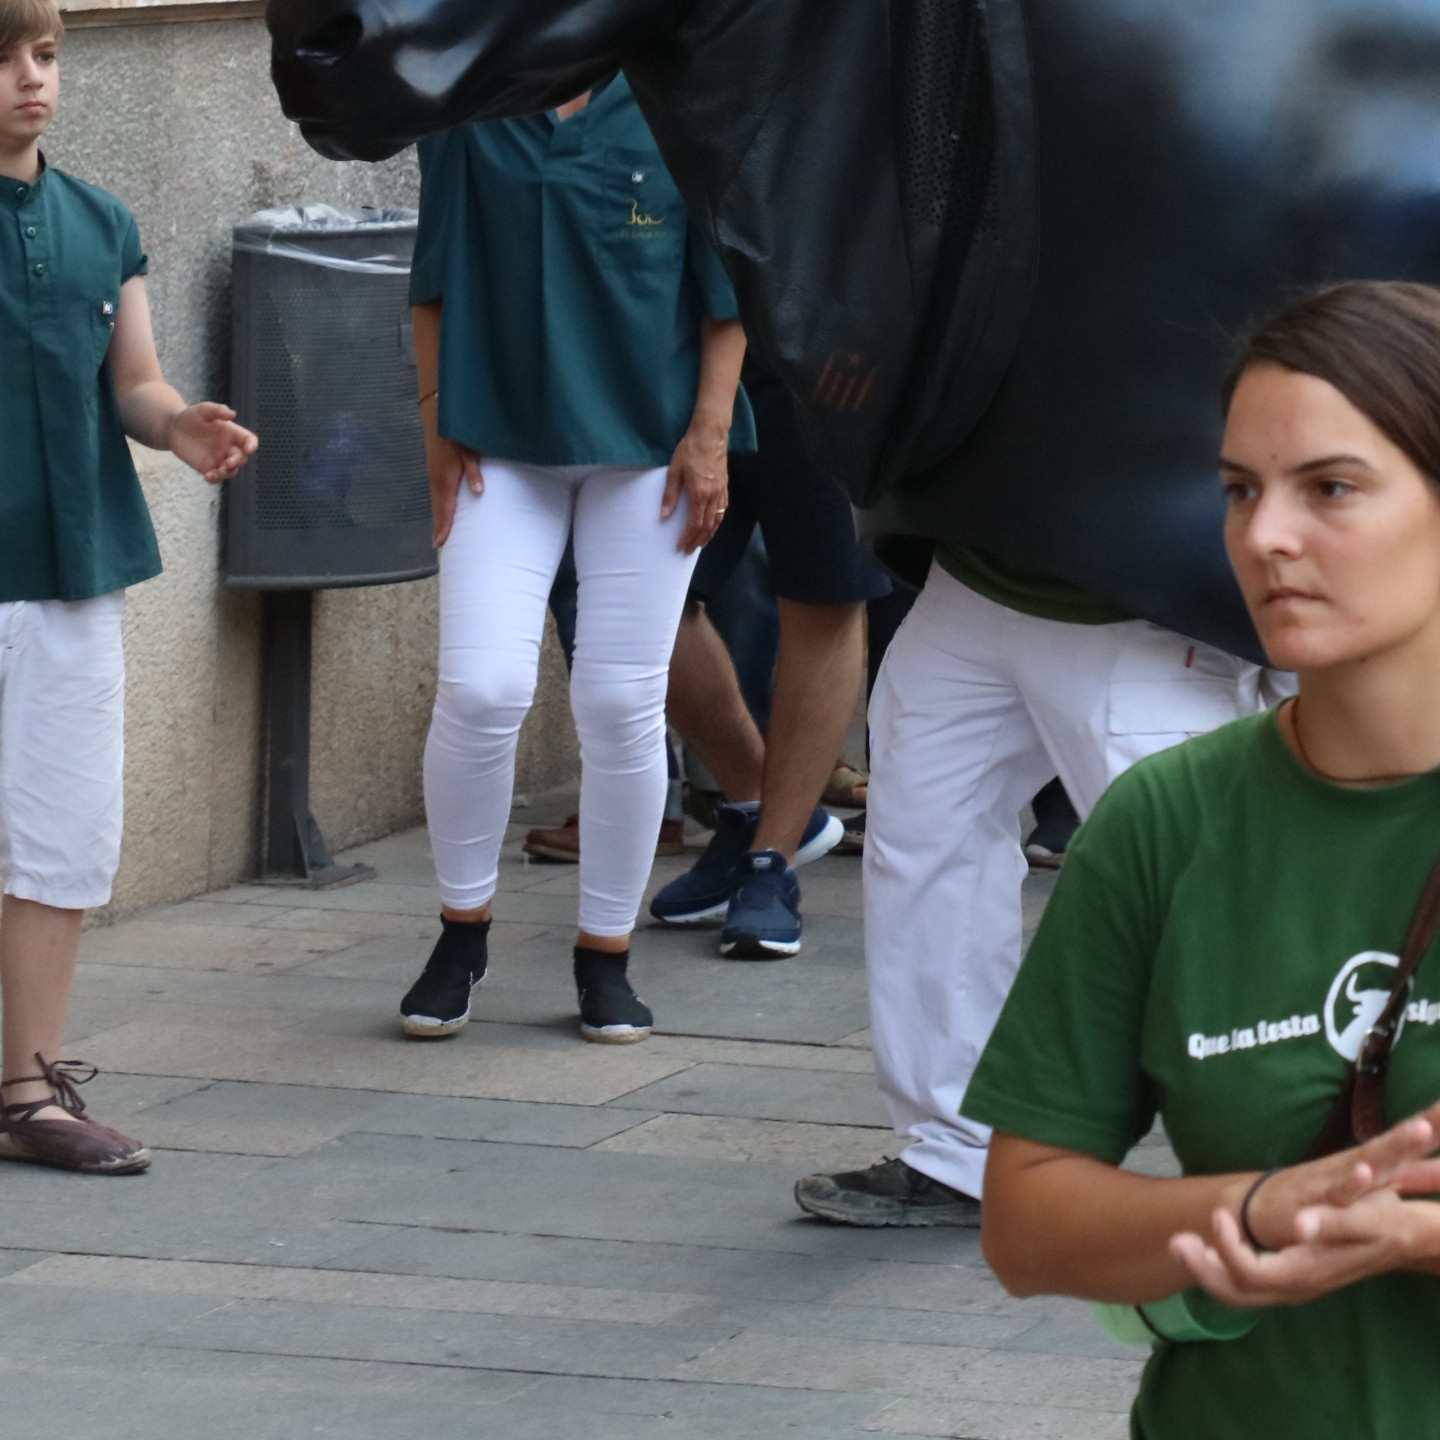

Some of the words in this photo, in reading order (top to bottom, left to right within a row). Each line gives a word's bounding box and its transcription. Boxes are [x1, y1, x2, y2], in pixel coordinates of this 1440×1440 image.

[1187, 1032, 1231, 1061] Que
[1231, 1027, 1257, 1051] la
[1257, 1013, 1321, 1046] festa
